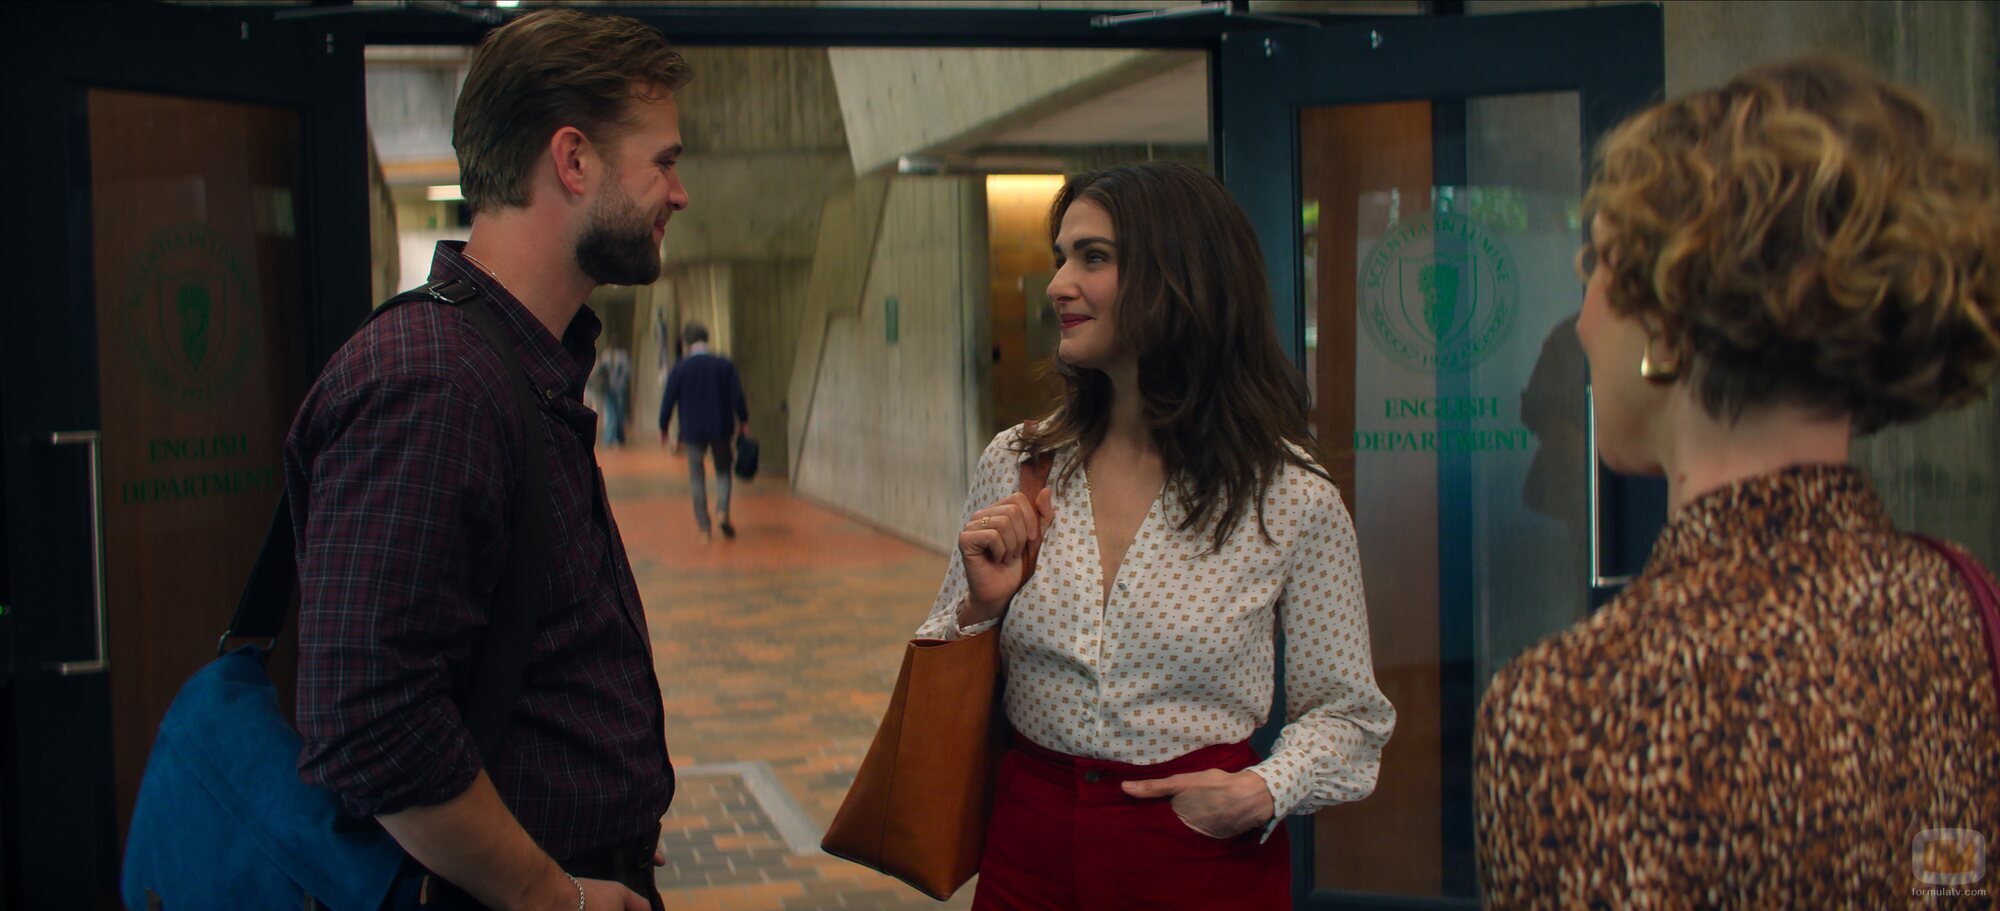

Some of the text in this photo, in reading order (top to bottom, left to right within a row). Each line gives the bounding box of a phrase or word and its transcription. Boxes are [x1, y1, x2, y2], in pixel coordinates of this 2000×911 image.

[1434, 219, 1455, 233] IN
[1385, 397, 1498, 418] ENGLISH
[150, 432, 249, 464] ENGLISH
[1353, 430, 1534, 450] DEPARTMENT
[122, 466, 275, 504] DEPARTMENT
